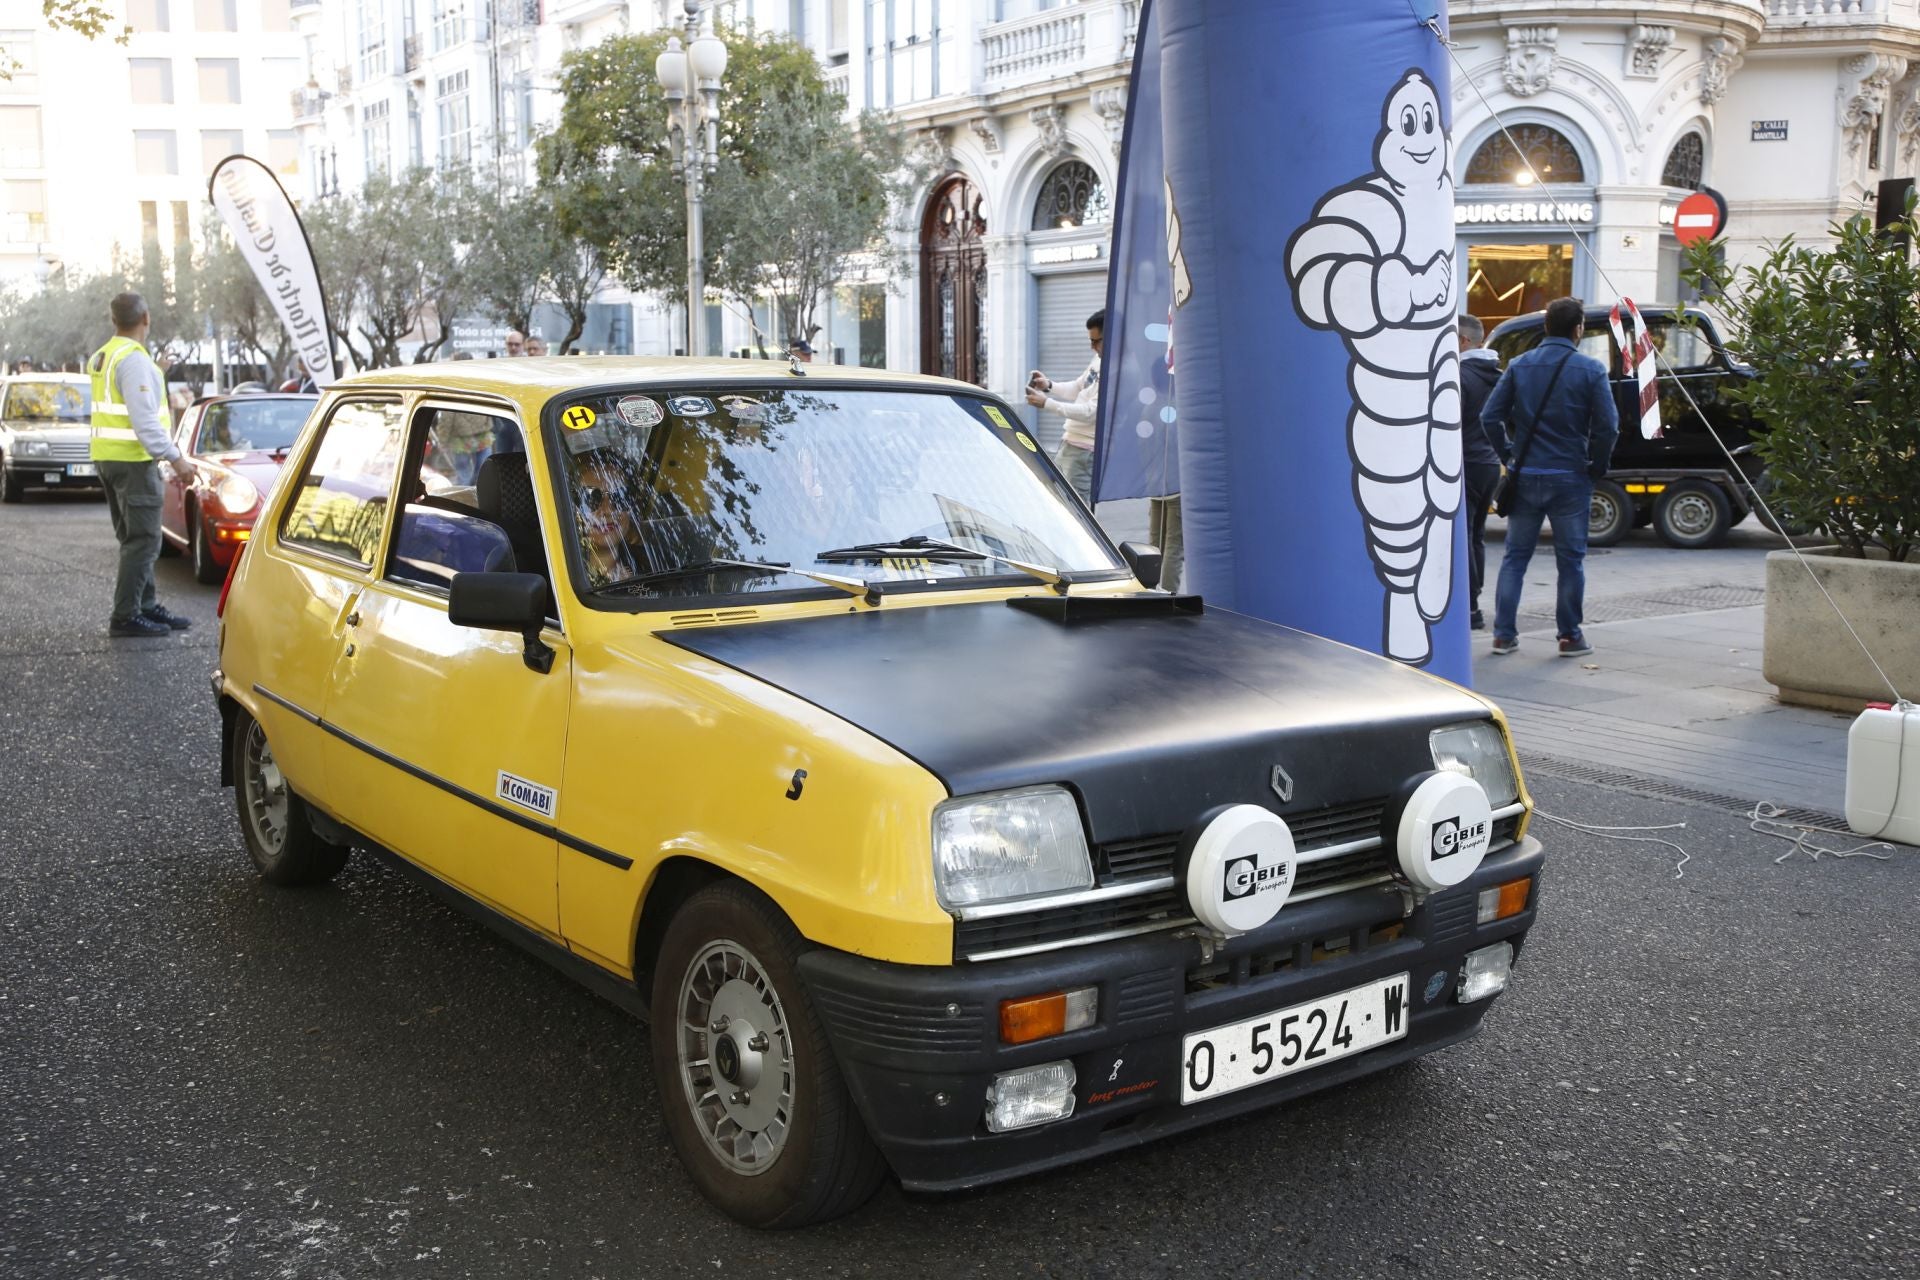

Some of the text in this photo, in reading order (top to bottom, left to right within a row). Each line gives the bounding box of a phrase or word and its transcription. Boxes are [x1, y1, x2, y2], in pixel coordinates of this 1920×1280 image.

[1763, 121, 1786, 129] CALLE
[1753, 131, 1786, 140] MANTILLA
[1455, 203, 1593, 223] BURGER KING
[452, 326, 479, 337] Todo
[480, 329, 493, 337] es
[453, 339, 492, 348] cuando
[569, 408, 590, 427] H
[511, 783, 550, 810] COMABI
[1442, 823, 1484, 846] CIBIE
[1237, 864, 1287, 886] CIBIE
[1256, 877, 1288, 893] Farosport
[1116, 1080, 1159, 1095] motor
